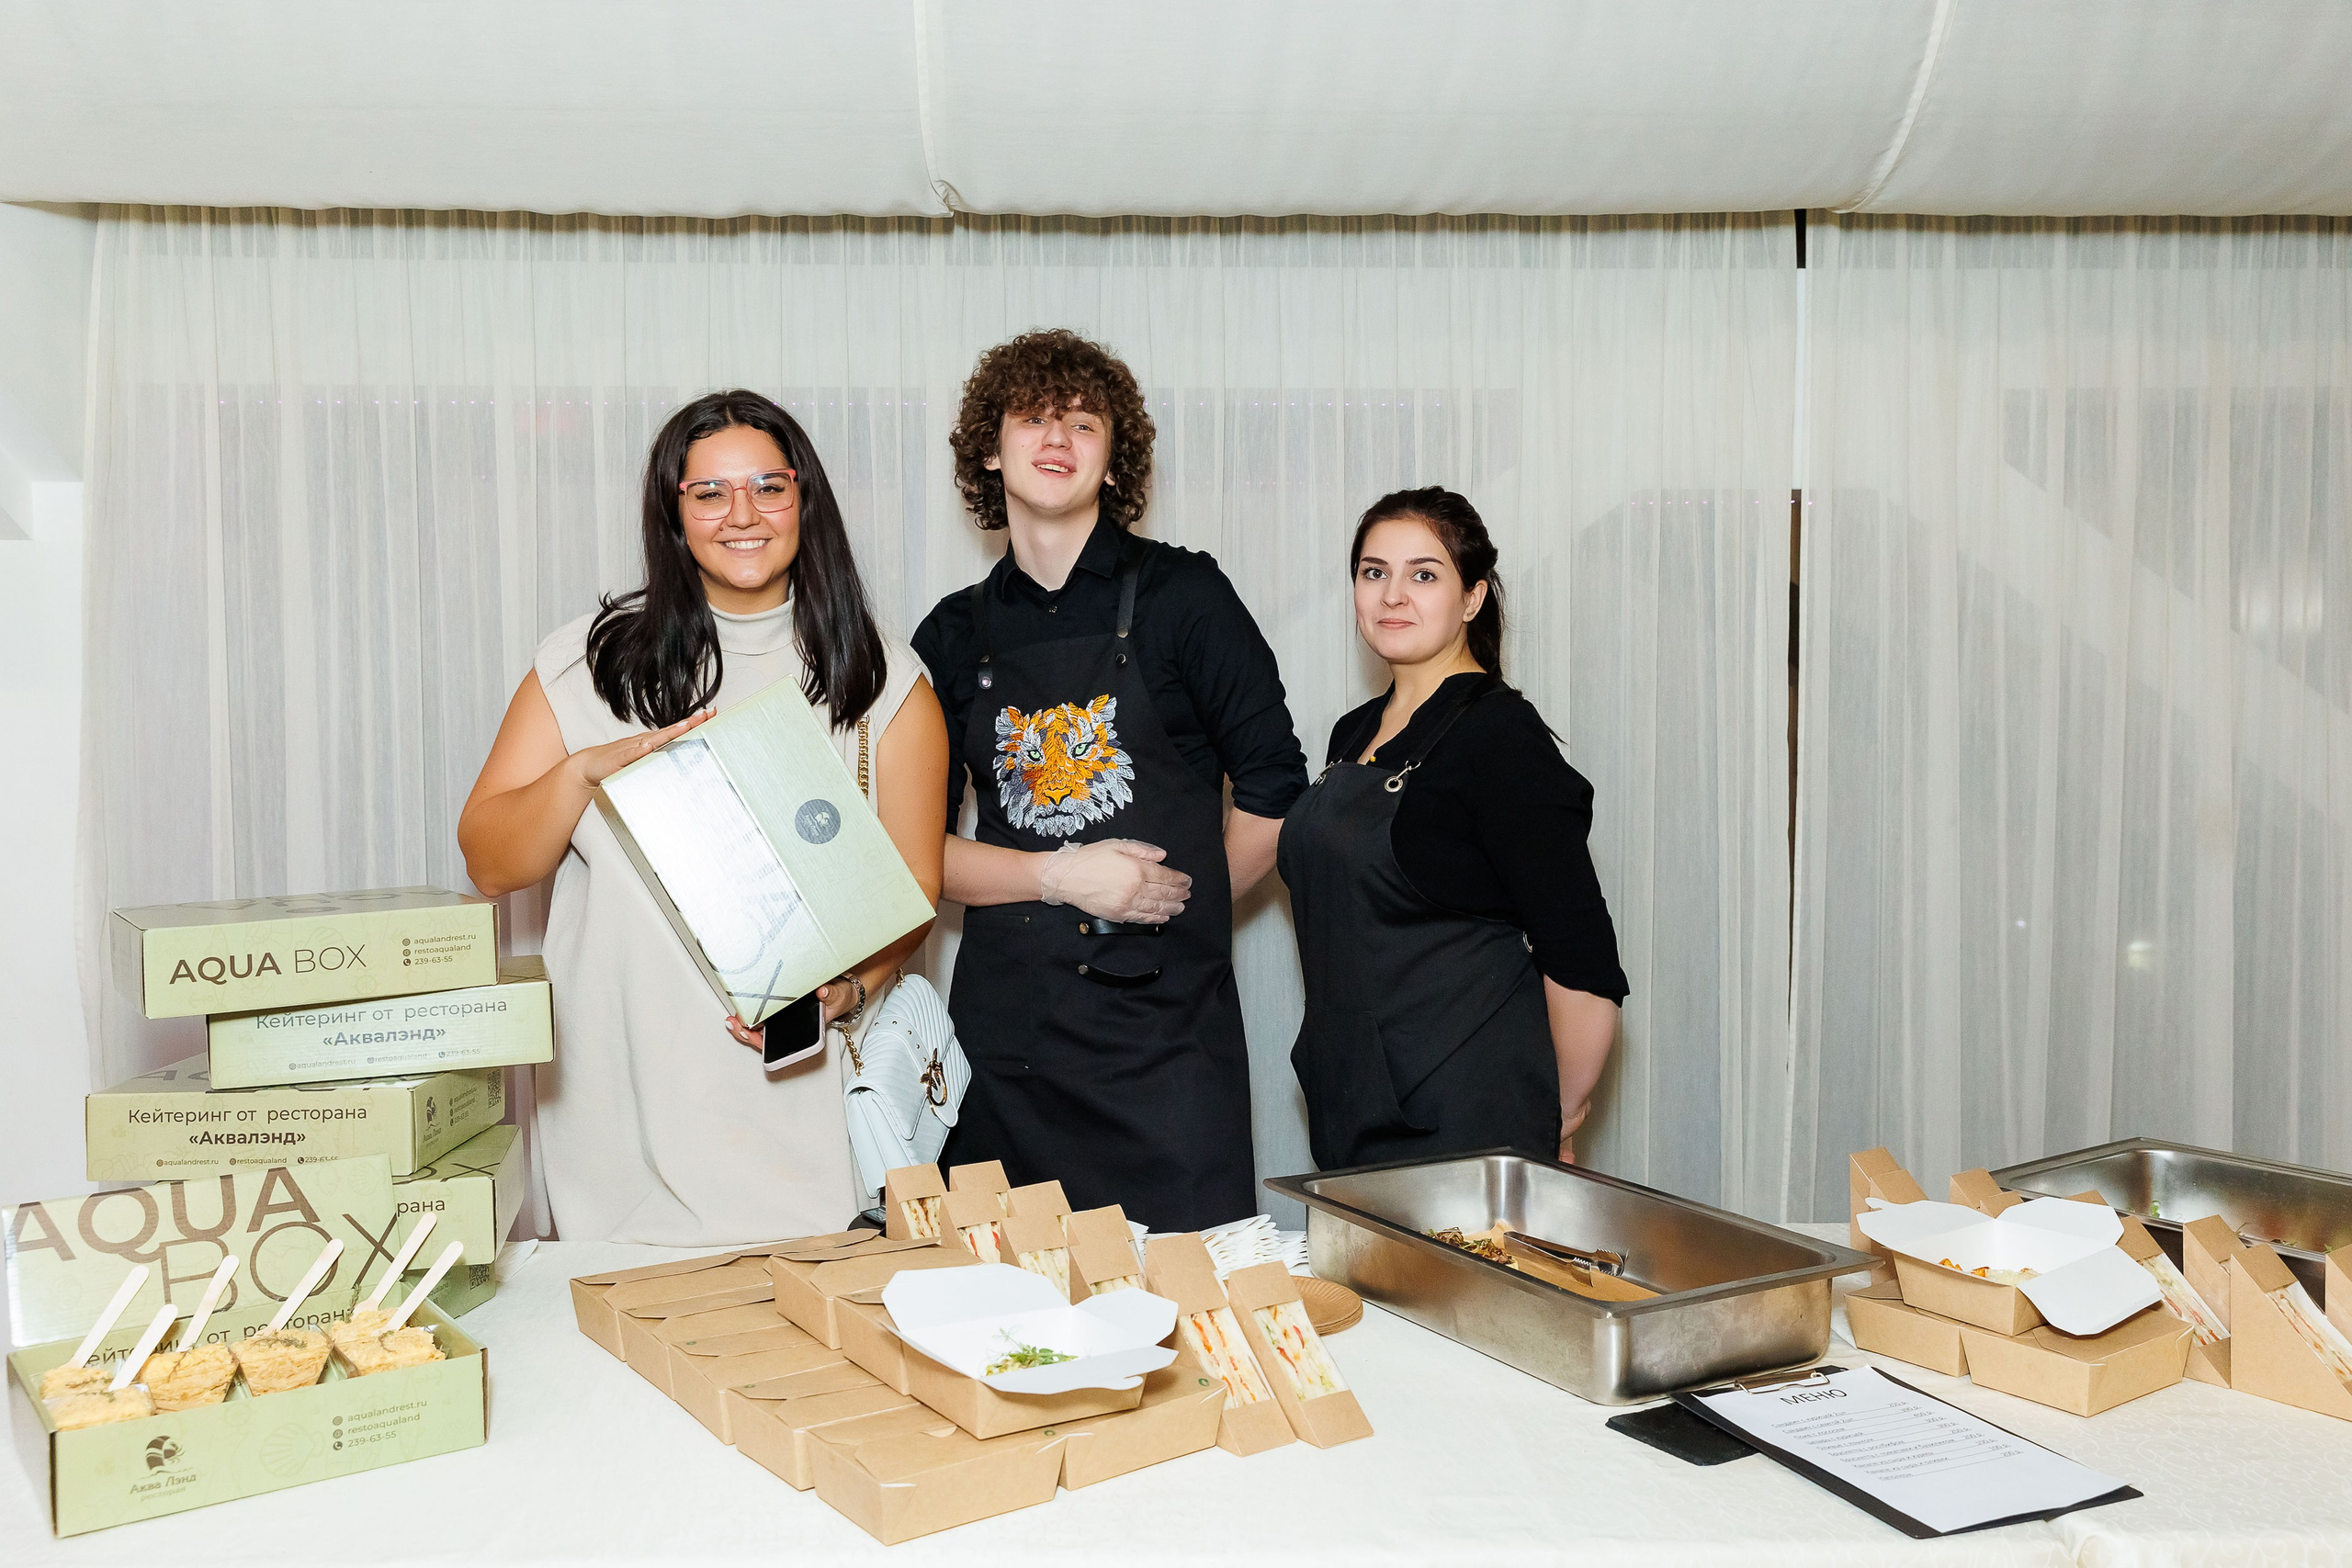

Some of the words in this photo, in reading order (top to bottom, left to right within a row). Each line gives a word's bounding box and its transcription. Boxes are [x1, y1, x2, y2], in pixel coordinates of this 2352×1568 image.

[413, 933, 477, 945] aqualandrest.ru
[413, 943, 471, 955] restoaqualand
[169, 952, 282, 986] AQUA
[295, 944, 367, 974] BOX
[414, 955, 453, 965] 239-63-55
[256, 1010, 367, 1029] Кейтеринг
[372, 1009, 393, 1021] от
[404, 999, 507, 1021] ресторана
[322, 1026, 447, 1046] «Аквалэнд»
[297, 1058, 356, 1069] aqualandrest.ru
[129, 1109, 232, 1125] Кейтеринг
[236, 1110, 257, 1122] от
[267, 1106, 367, 1123] ресторана
[188, 1131, 306, 1145] «Аквалэнд»
[164, 1158, 219, 1167] aqualandrest.ru
[237, 1157, 288, 1166] restoaqualand
[6, 1166, 320, 1264] AQUA
[159, 1212, 398, 1320] BOX
[207, 1330, 231, 1344] от
[1780, 1389, 1848, 1405] МЕНЮ
[347, 1399, 427, 1423] aqualandrest.ru
[347, 1413, 421, 1435] restoaqualand
[347, 1430, 397, 1448] 239-63-55
